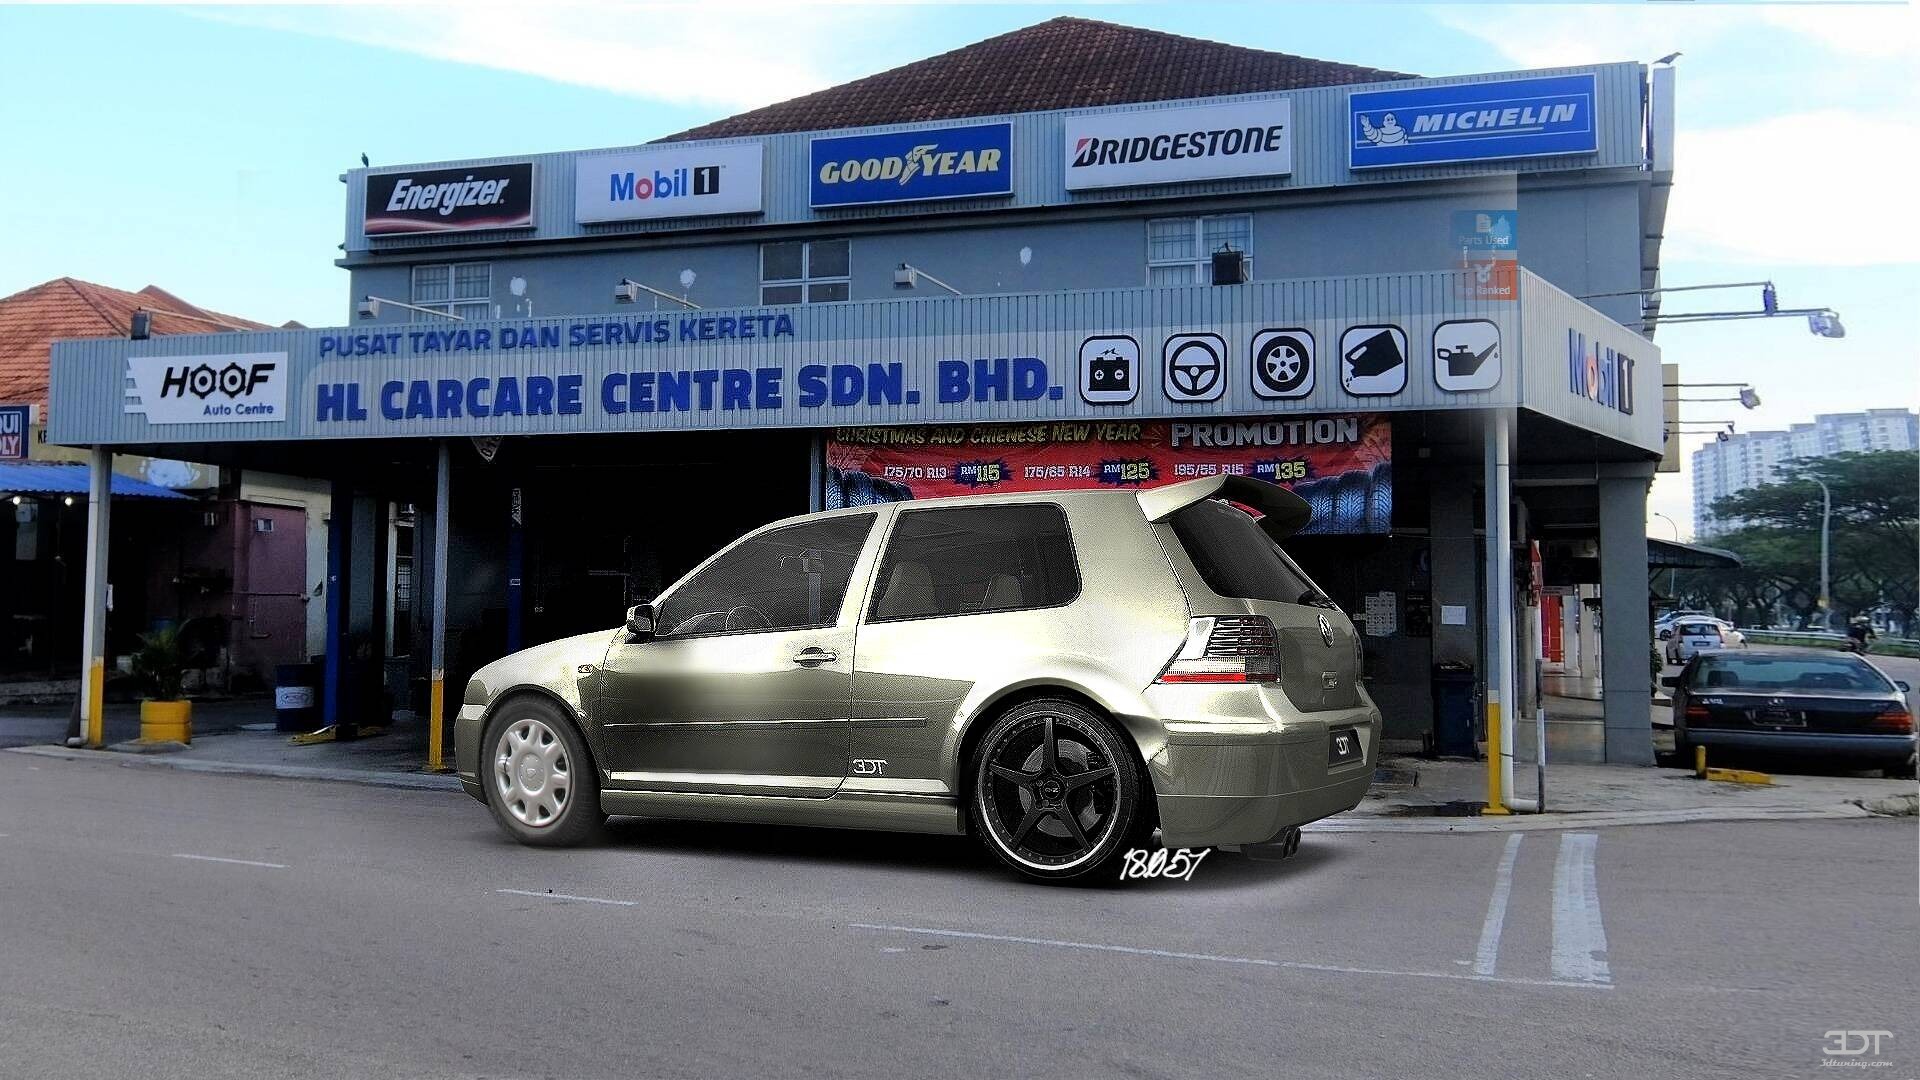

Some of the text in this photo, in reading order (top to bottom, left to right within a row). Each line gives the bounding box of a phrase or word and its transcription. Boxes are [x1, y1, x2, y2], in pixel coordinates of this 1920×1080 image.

[1413, 103, 1577, 133] MICHELIN
[1072, 125, 1283, 168] BRIDGESTONE
[386, 174, 510, 215] Energizer
[610, 168, 688, 202] Mobil
[320, 314, 795, 358] PUSAT TAYAR DAN SERVIS KERETA
[160, 363, 276, 400] HOOF
[1568, 327, 1616, 410] Mobil
[316, 357, 1064, 422] HL CARCARE CENTRE SDN. BHD.
[0, 414, 19, 434] UI
[203, 402, 274, 416] Auto Centre
[0, 435, 19, 455] LY
[835, 425, 928, 444] CHRISTMAS
[929, 426, 965, 444] AND
[1051, 422, 1090, 441] NEW
[1096, 422, 1141, 441] YEAR
[1171, 418, 1358, 447] PROMOTION
[884, 466, 923, 479] 175/70
[853, 758, 888, 775] 3DT
